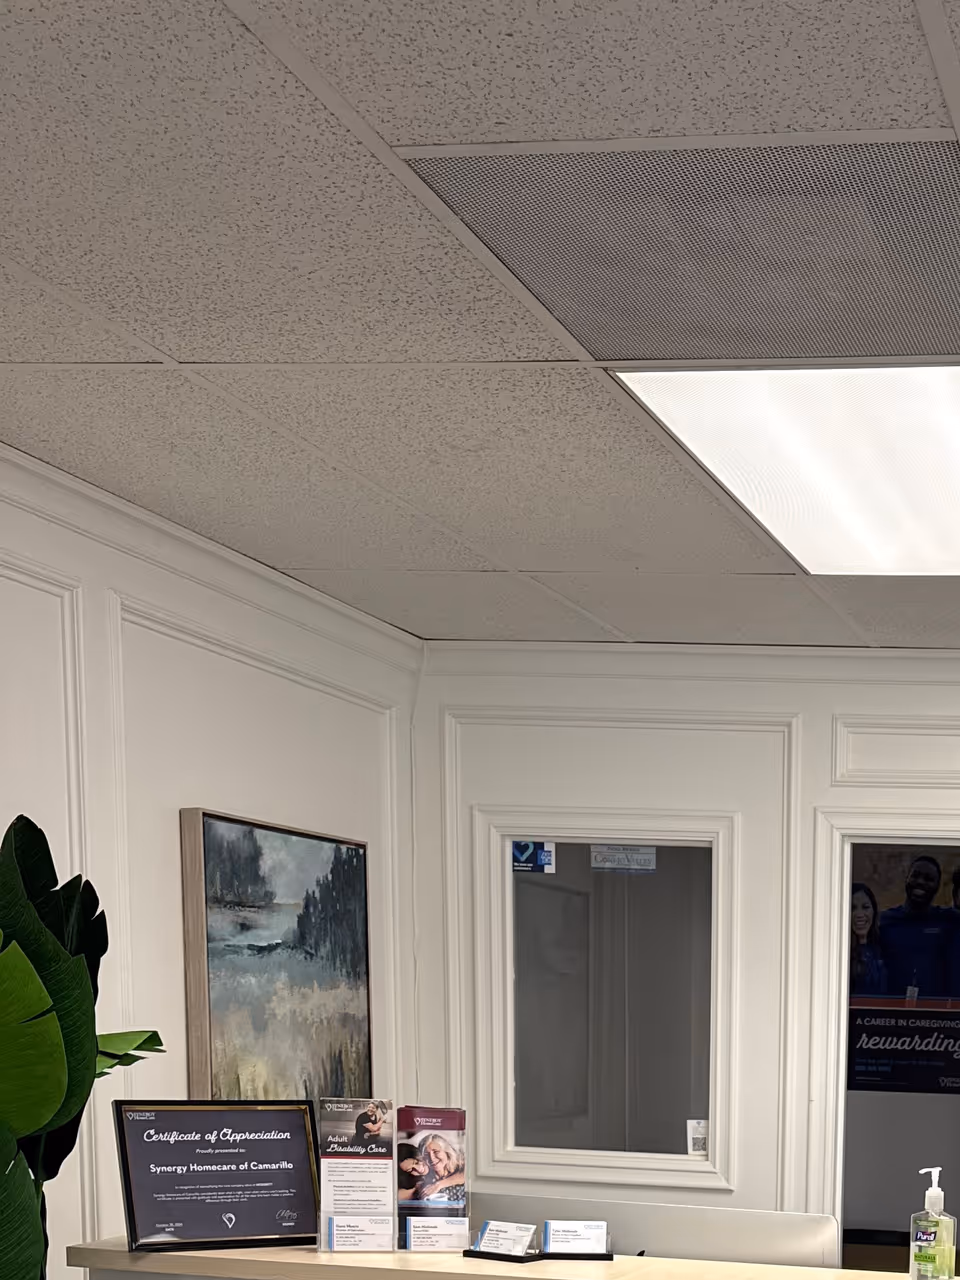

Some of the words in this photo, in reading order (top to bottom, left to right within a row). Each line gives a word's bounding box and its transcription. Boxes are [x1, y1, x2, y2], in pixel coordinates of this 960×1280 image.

[864, 1017, 895, 1026] CAREER
[898, 1018, 907, 1026] IN
[909, 1018, 960, 1028] CAREGIVING
[143, 1128, 201, 1144] Certificate
[205, 1130, 218, 1144] of
[219, 1128, 291, 1144] Appreciation
[327, 1135, 348, 1143] Adult
[326, 1144, 366, 1155] Disability
[367, 1144, 387, 1153] Care
[149, 1163, 187, 1174] Synergy
[189, 1163, 237, 1172] Homecare
[239, 1162, 249, 1170] of
[250, 1160, 294, 1171] Camarillo
